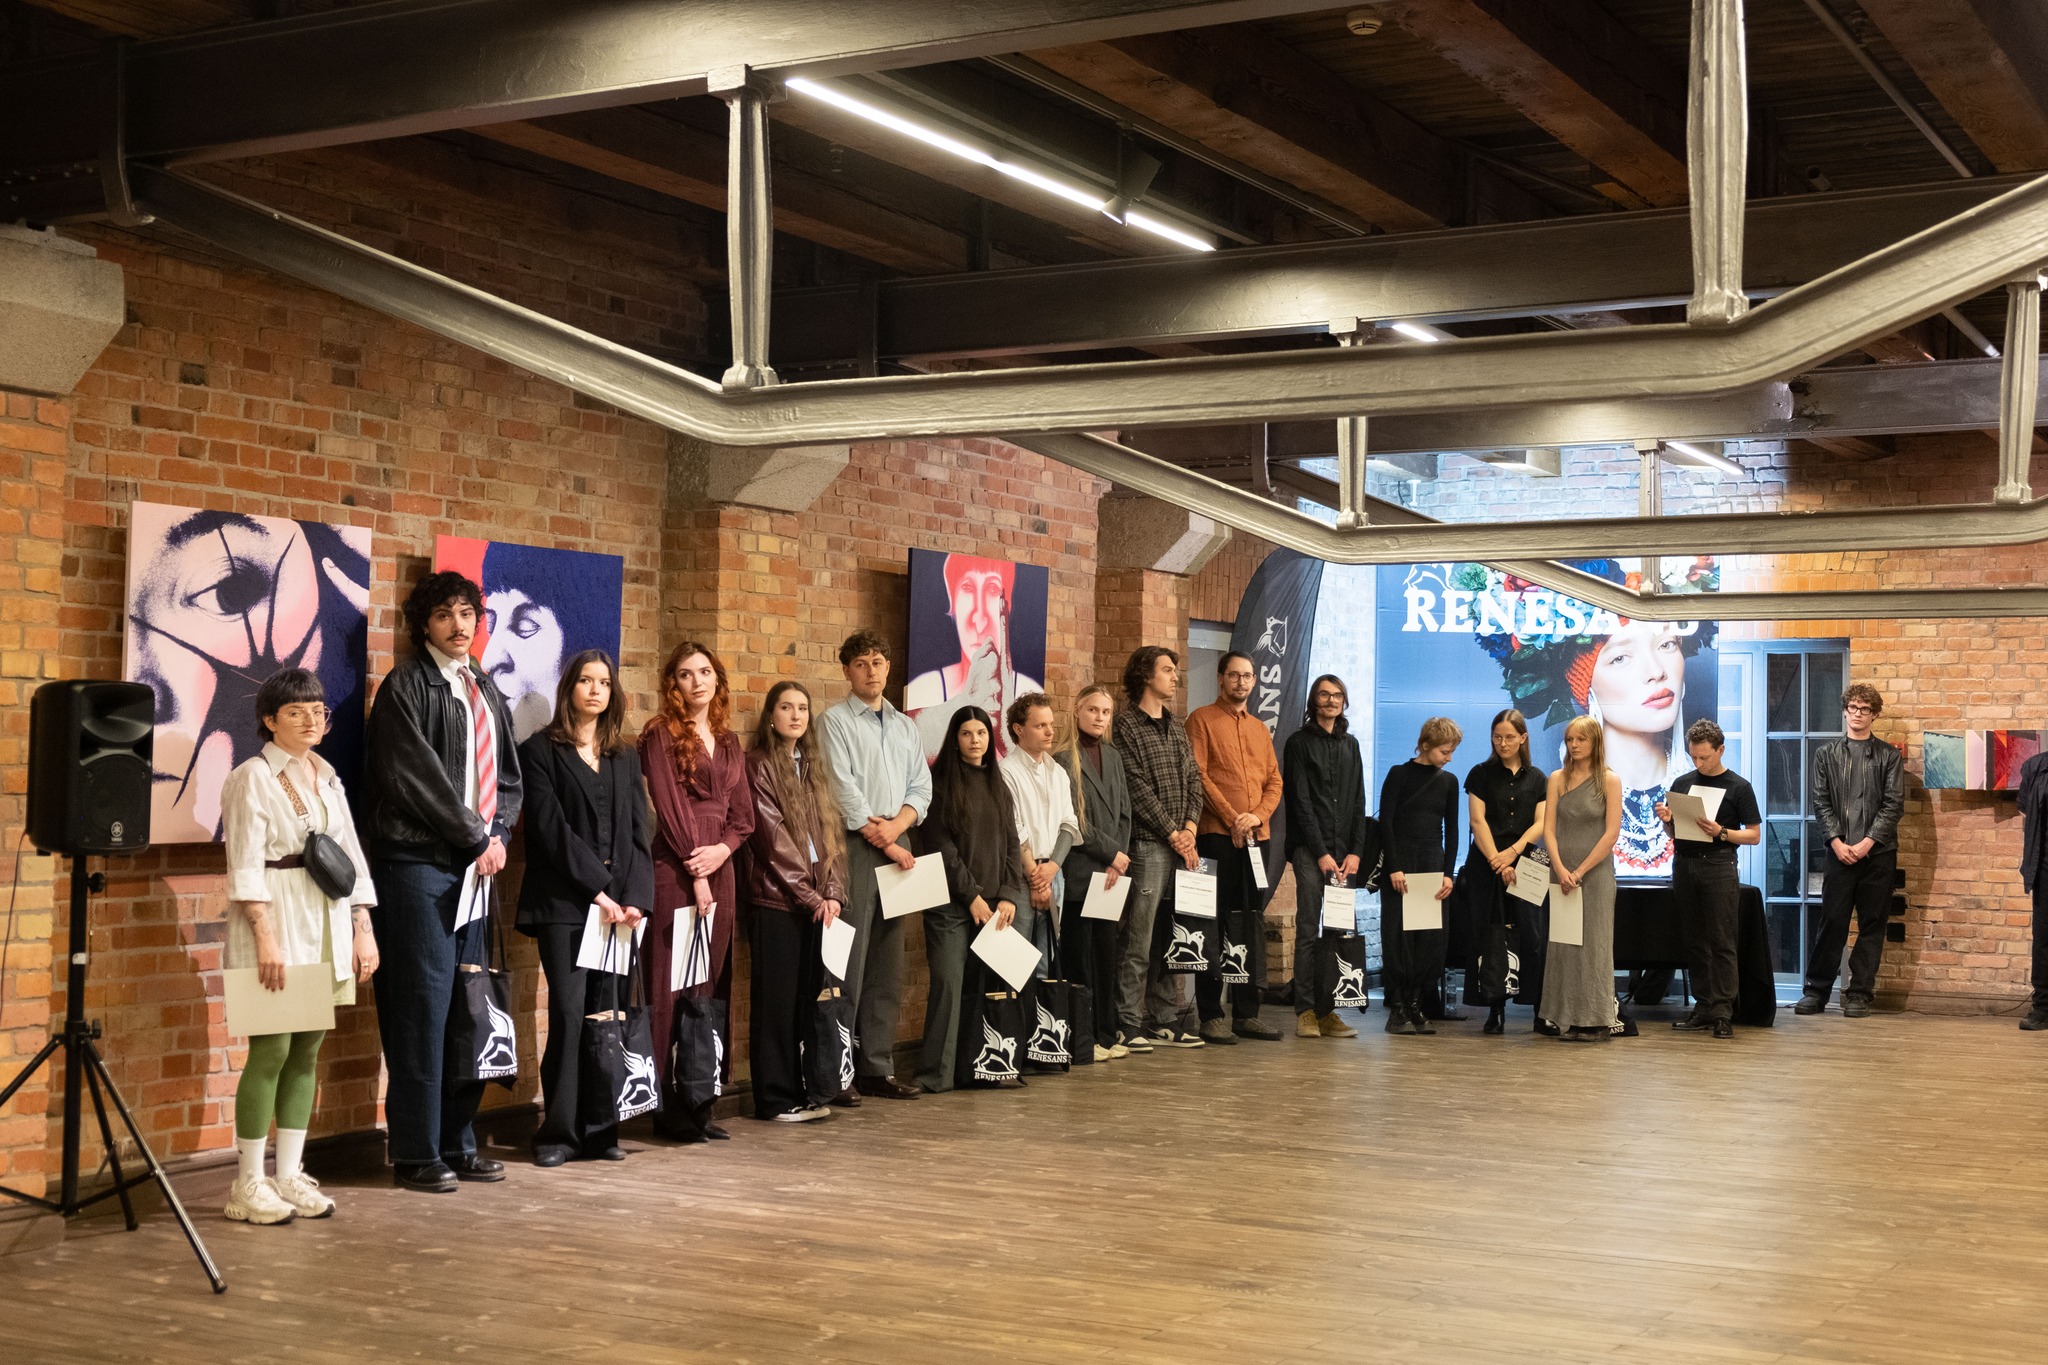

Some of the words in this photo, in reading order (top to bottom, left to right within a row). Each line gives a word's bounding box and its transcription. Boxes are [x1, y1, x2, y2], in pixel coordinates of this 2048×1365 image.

[1402, 589, 1699, 636] RENESA
[1168, 963, 1208, 971] RENESANS
[1027, 1051, 1068, 1063] RENESANS
[974, 1071, 1018, 1081] RENESANS
[619, 1100, 659, 1121] RENESANS
